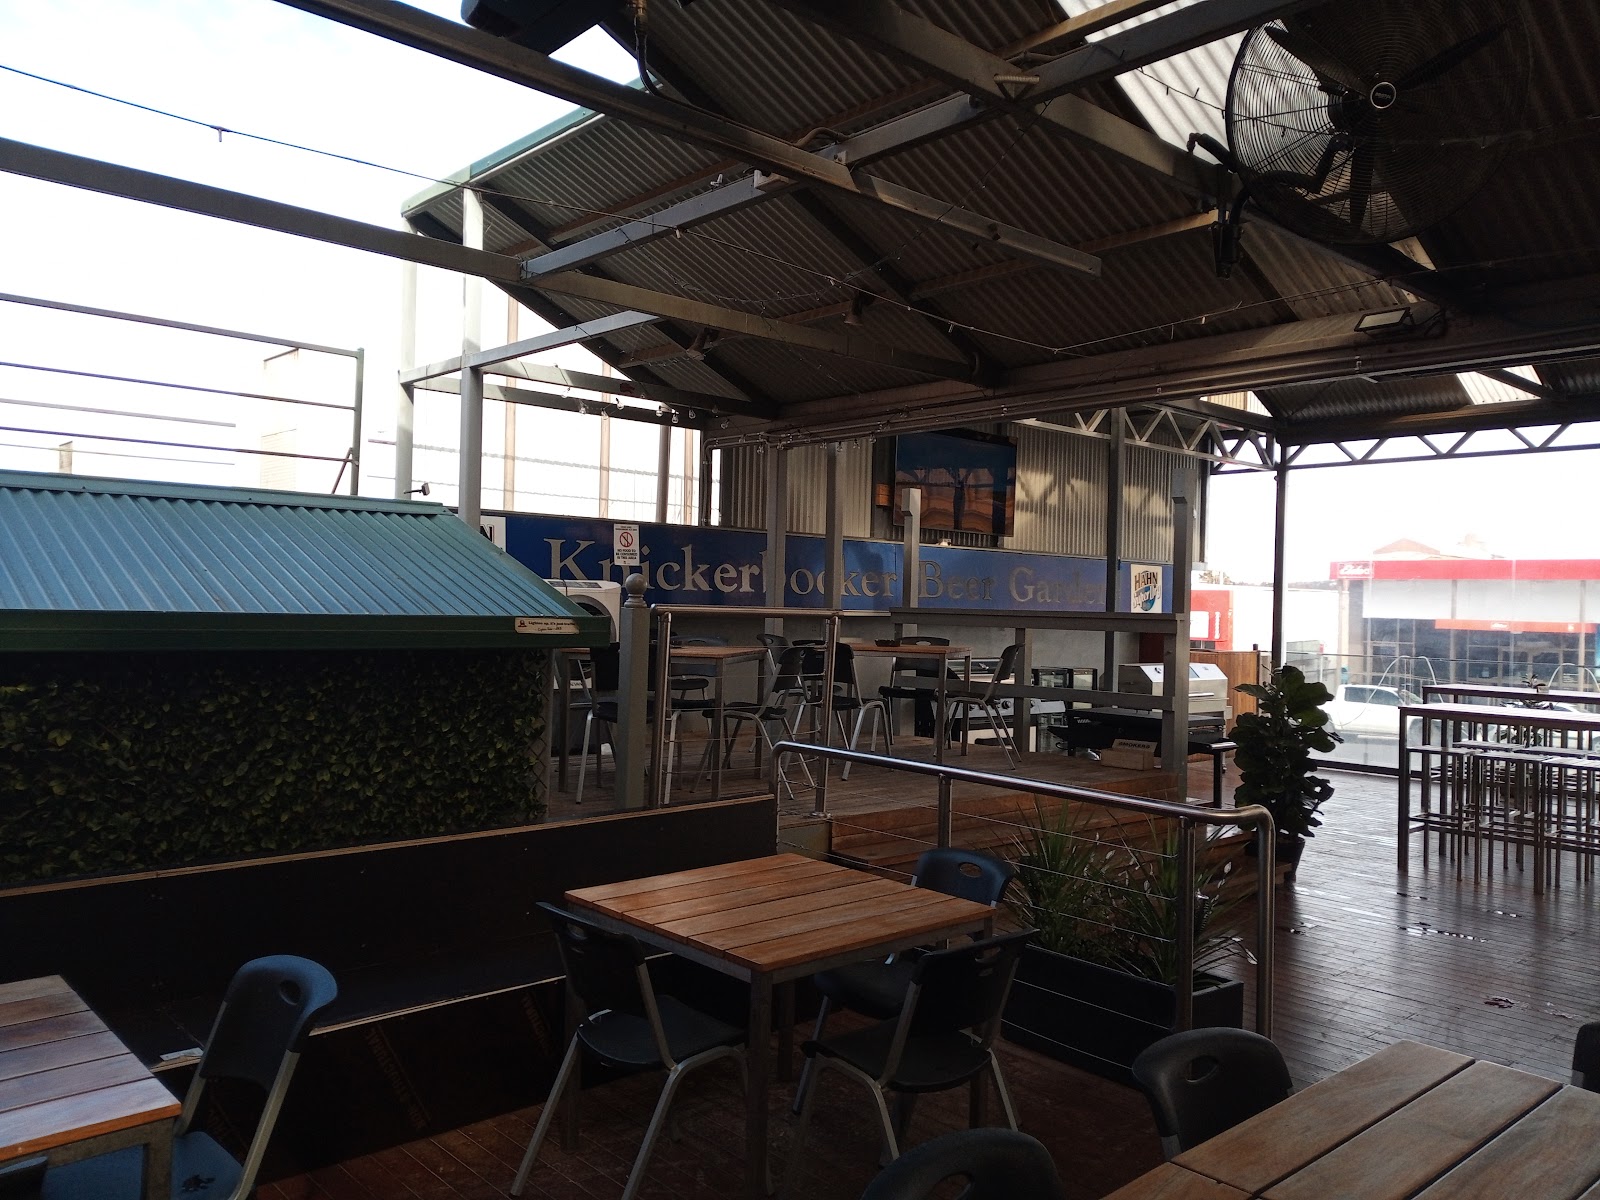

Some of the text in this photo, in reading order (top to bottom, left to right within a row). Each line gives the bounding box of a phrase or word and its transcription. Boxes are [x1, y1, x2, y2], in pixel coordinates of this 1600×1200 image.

[544, 538, 1106, 605] Knickeroker Beer Garden
[1134, 571, 1158, 591] HAHN
[1118, 741, 1151, 749] SMOKERS
